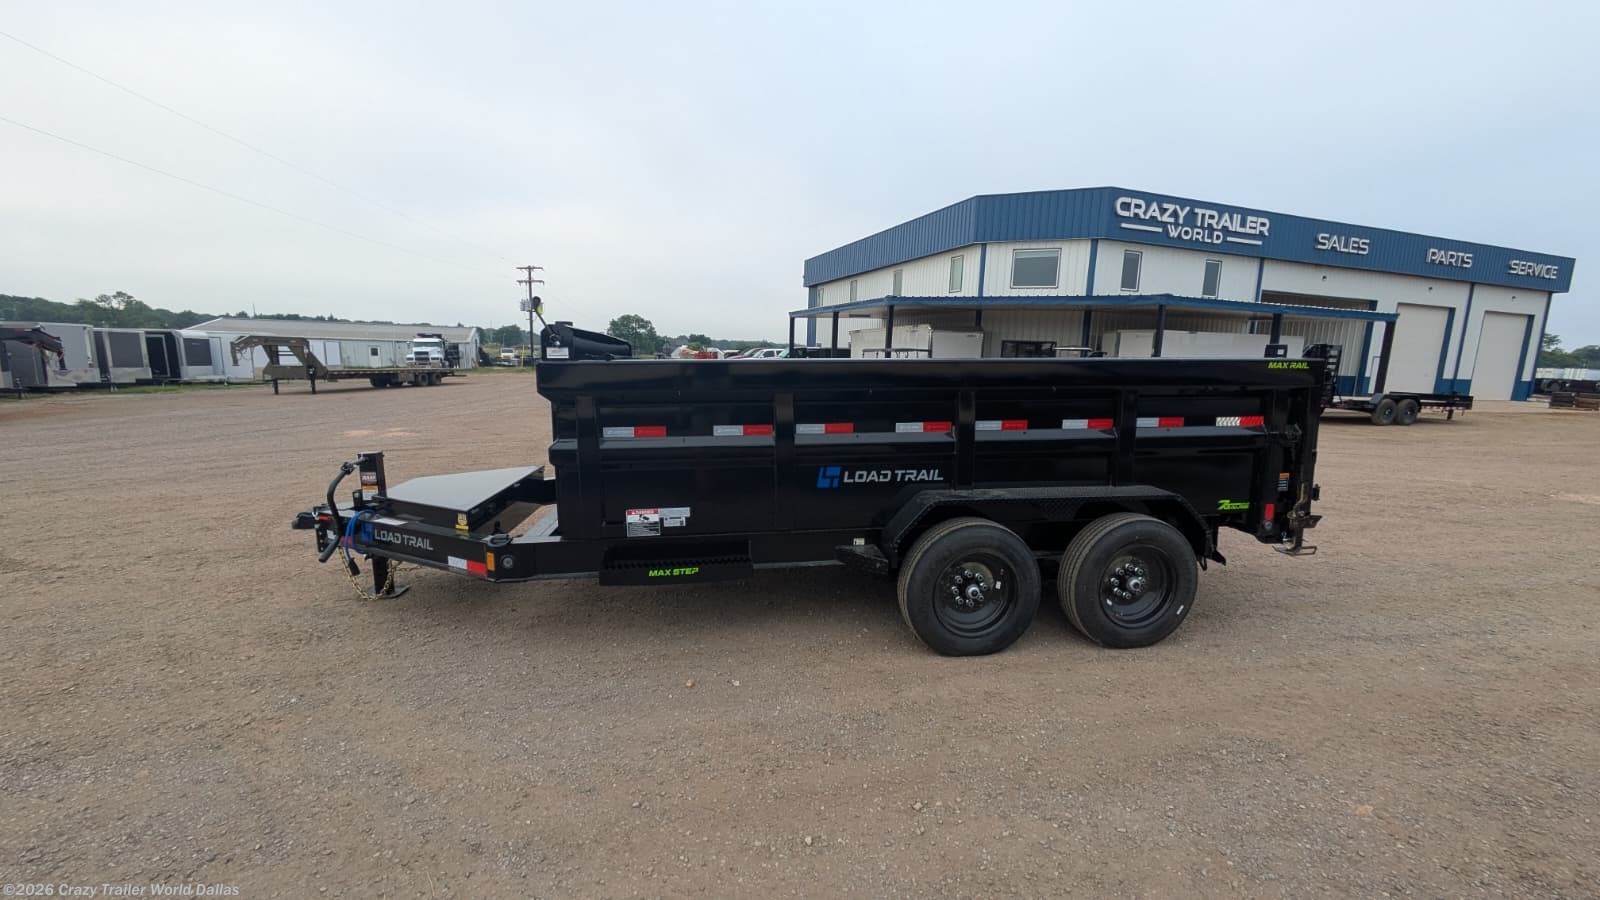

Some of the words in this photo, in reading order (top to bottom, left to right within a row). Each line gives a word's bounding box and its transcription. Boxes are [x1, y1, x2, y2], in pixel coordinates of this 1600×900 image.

[1115, 196, 1190, 225] CRAZY
[1194, 208, 1270, 236] TRAILER
[1167, 224, 1223, 244] WORLD
[1315, 233, 1370, 255] SALES
[1426, 248, 1473, 268] PARTS
[1509, 260, 1559, 280] SERVICE
[1268, 361, 1289, 369] MAX
[1290, 361, 1310, 369] RAIL
[843, 470, 892, 484] LOAD
[894, 469, 944, 482] TRAIL
[374, 528, 401, 544] LOAD
[402, 534, 434, 551] TRAIL
[648, 568, 672, 577] MAX
[672, 567, 699, 576] STEP
